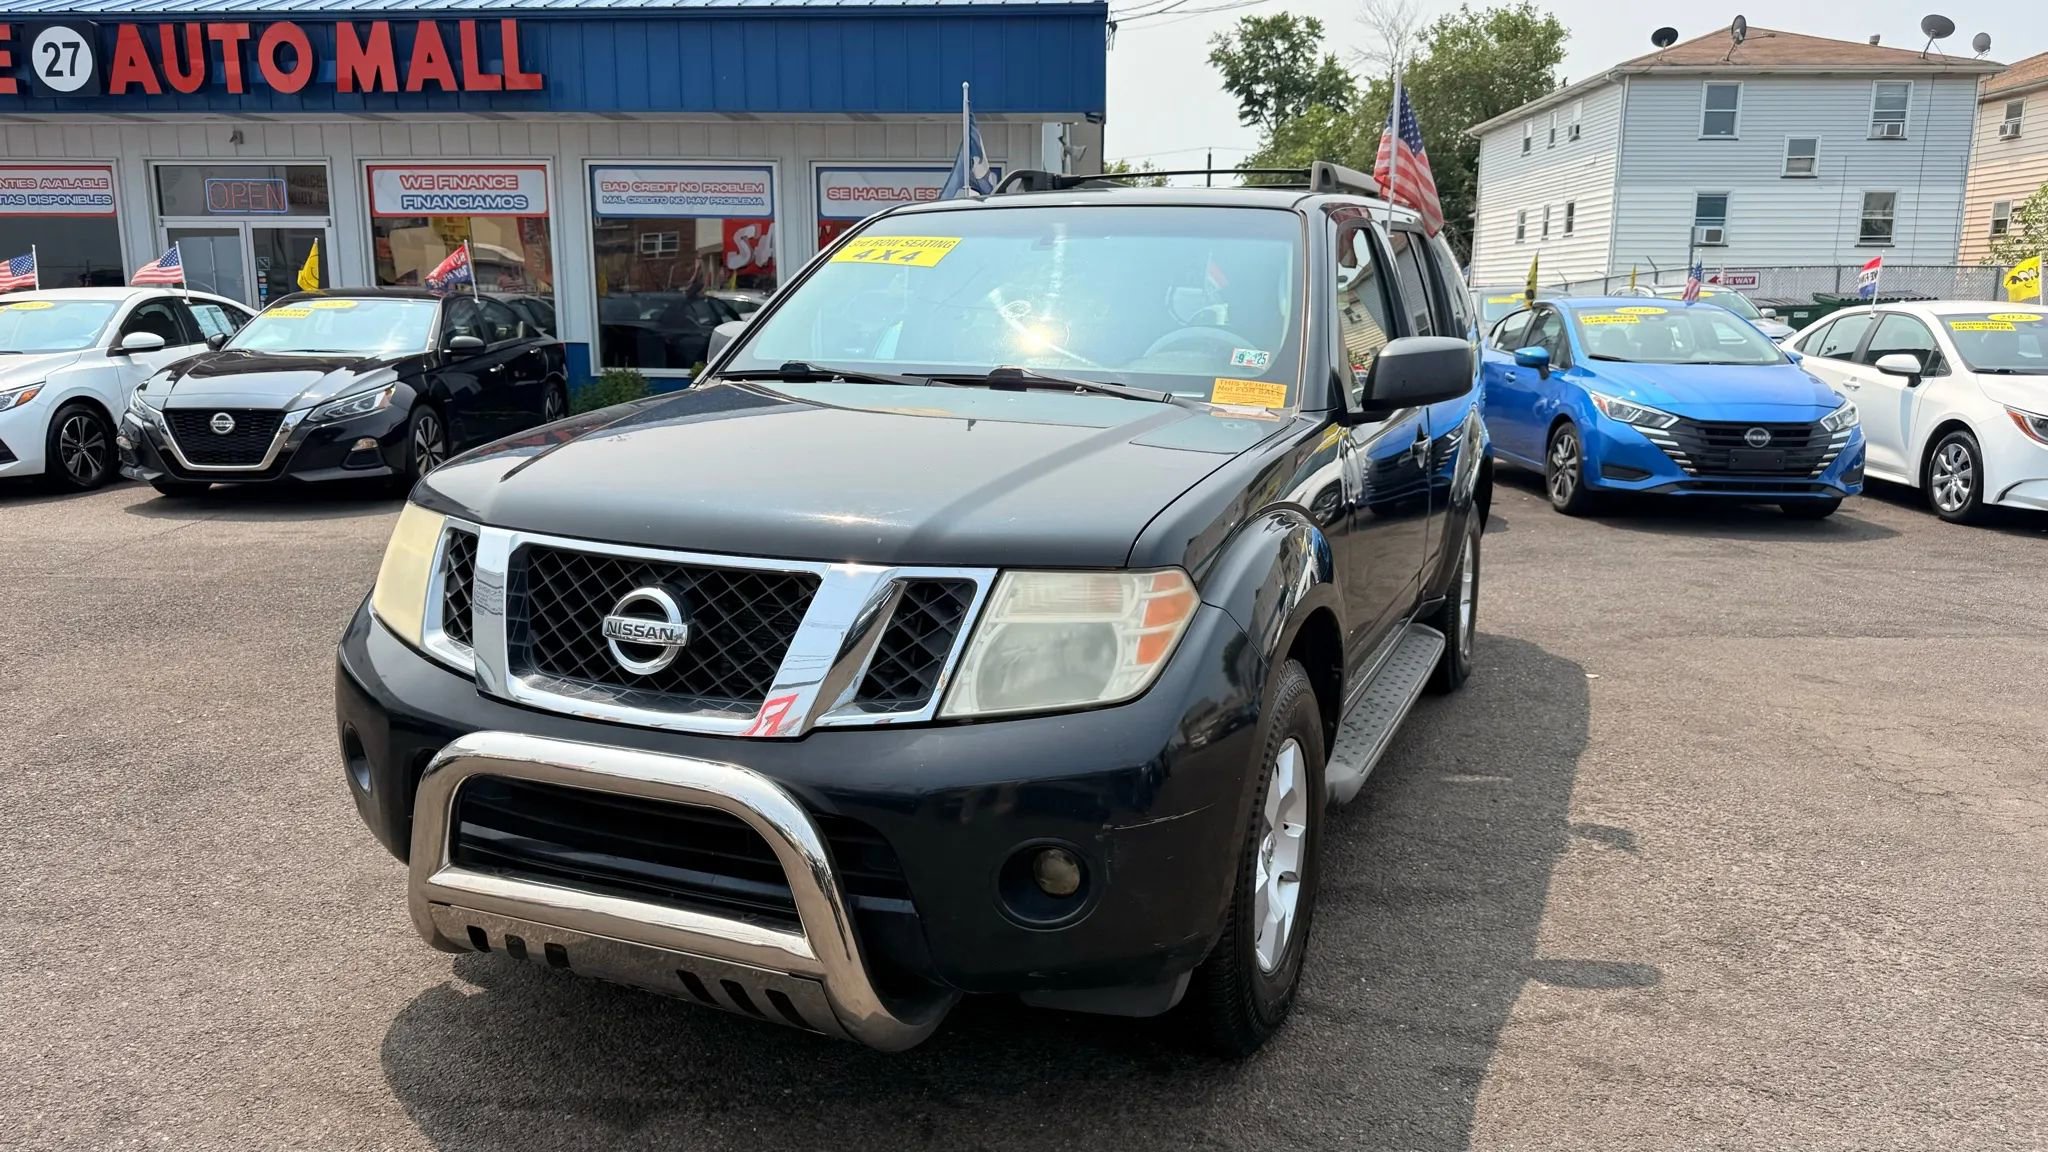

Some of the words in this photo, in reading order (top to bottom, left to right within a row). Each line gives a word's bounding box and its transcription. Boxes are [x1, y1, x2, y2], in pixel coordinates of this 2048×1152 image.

[42, 41, 81, 77] 27
[109, 20, 313, 94] AUTO
[336, 18, 543, 93] MALL
[40, 178, 108, 189] AVAILABLE
[400, 175, 434, 190] WE
[437, 175, 519, 190] FINANCE
[602, 182, 629, 192] BAD
[632, 182, 677, 193] CREDIT
[680, 182, 700, 193] NO
[702, 183, 764, 194] PROBLEM
[28, 194, 113, 205] DISPONIBLES
[209, 182, 284, 209] OPEN
[827, 187, 851, 200] SE
[851, 187, 913, 200] HABLA
[402, 195, 528, 210] FINANCIAMOS
[602, 195, 626, 204] MAL
[627, 196, 668, 204] CREDITO
[670, 196, 685, 204] NO
[686, 196, 709, 205] HAY
[710, 197, 764, 205] PROBLEMA
[873, 239, 902, 248] ROW
[900, 239, 956, 249] SEATING
[1237, 353, 1245, 364] 9
[606, 620, 675, 641] NISSAN
